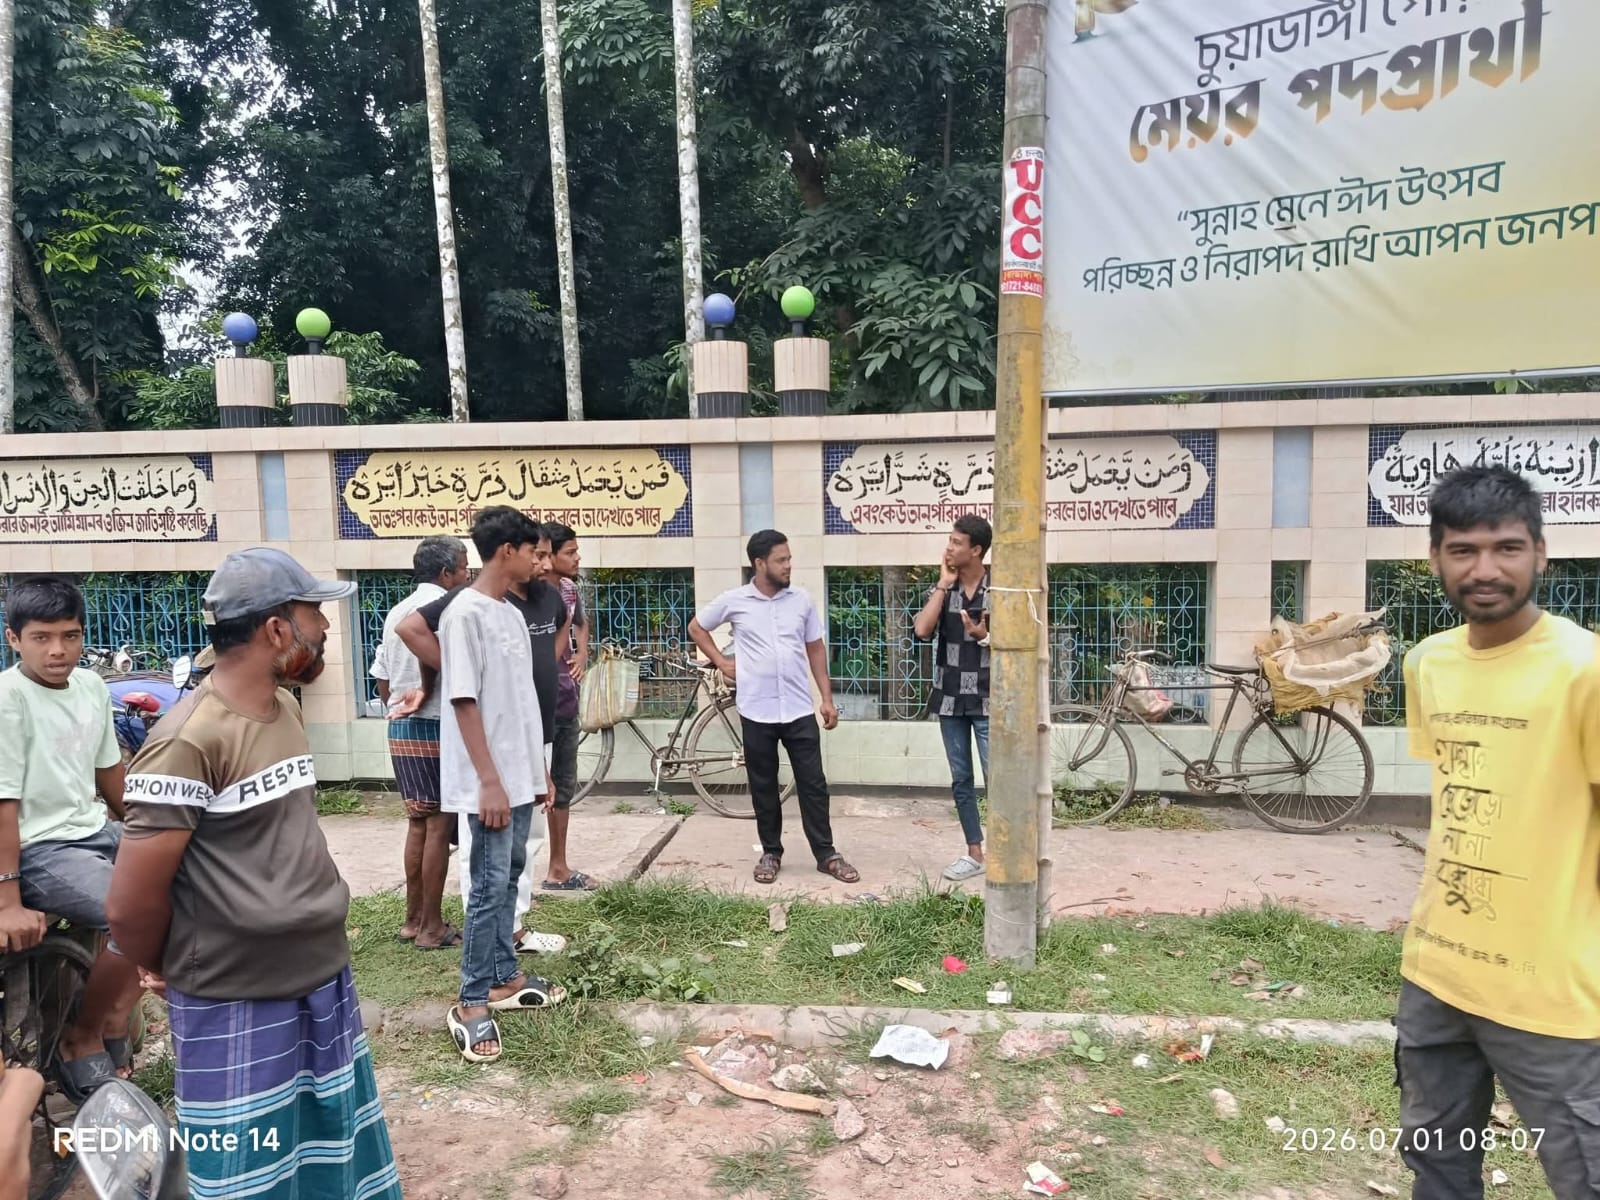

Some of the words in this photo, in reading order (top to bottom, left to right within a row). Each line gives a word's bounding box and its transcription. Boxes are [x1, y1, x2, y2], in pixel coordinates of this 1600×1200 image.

[1129, 78, 1267, 163] মেয়র
[1010, 159, 1043, 260] UCC
[1265, 189, 1331, 230] মেনে
[1334, 175, 1393, 214] ঈদ
[1393, 160, 1505, 207] উৎসব
[1082, 256, 1175, 294] পরিচ্ছন্ন
[1181, 256, 1198, 283] ও
[1203, 242, 1306, 281] নিরাপদ
[1312, 225, 1379, 272] রাখি
[1383, 217, 1490, 258] আপন
[0, 515, 19, 533] রার
[124, 778, 177, 797] SHION
